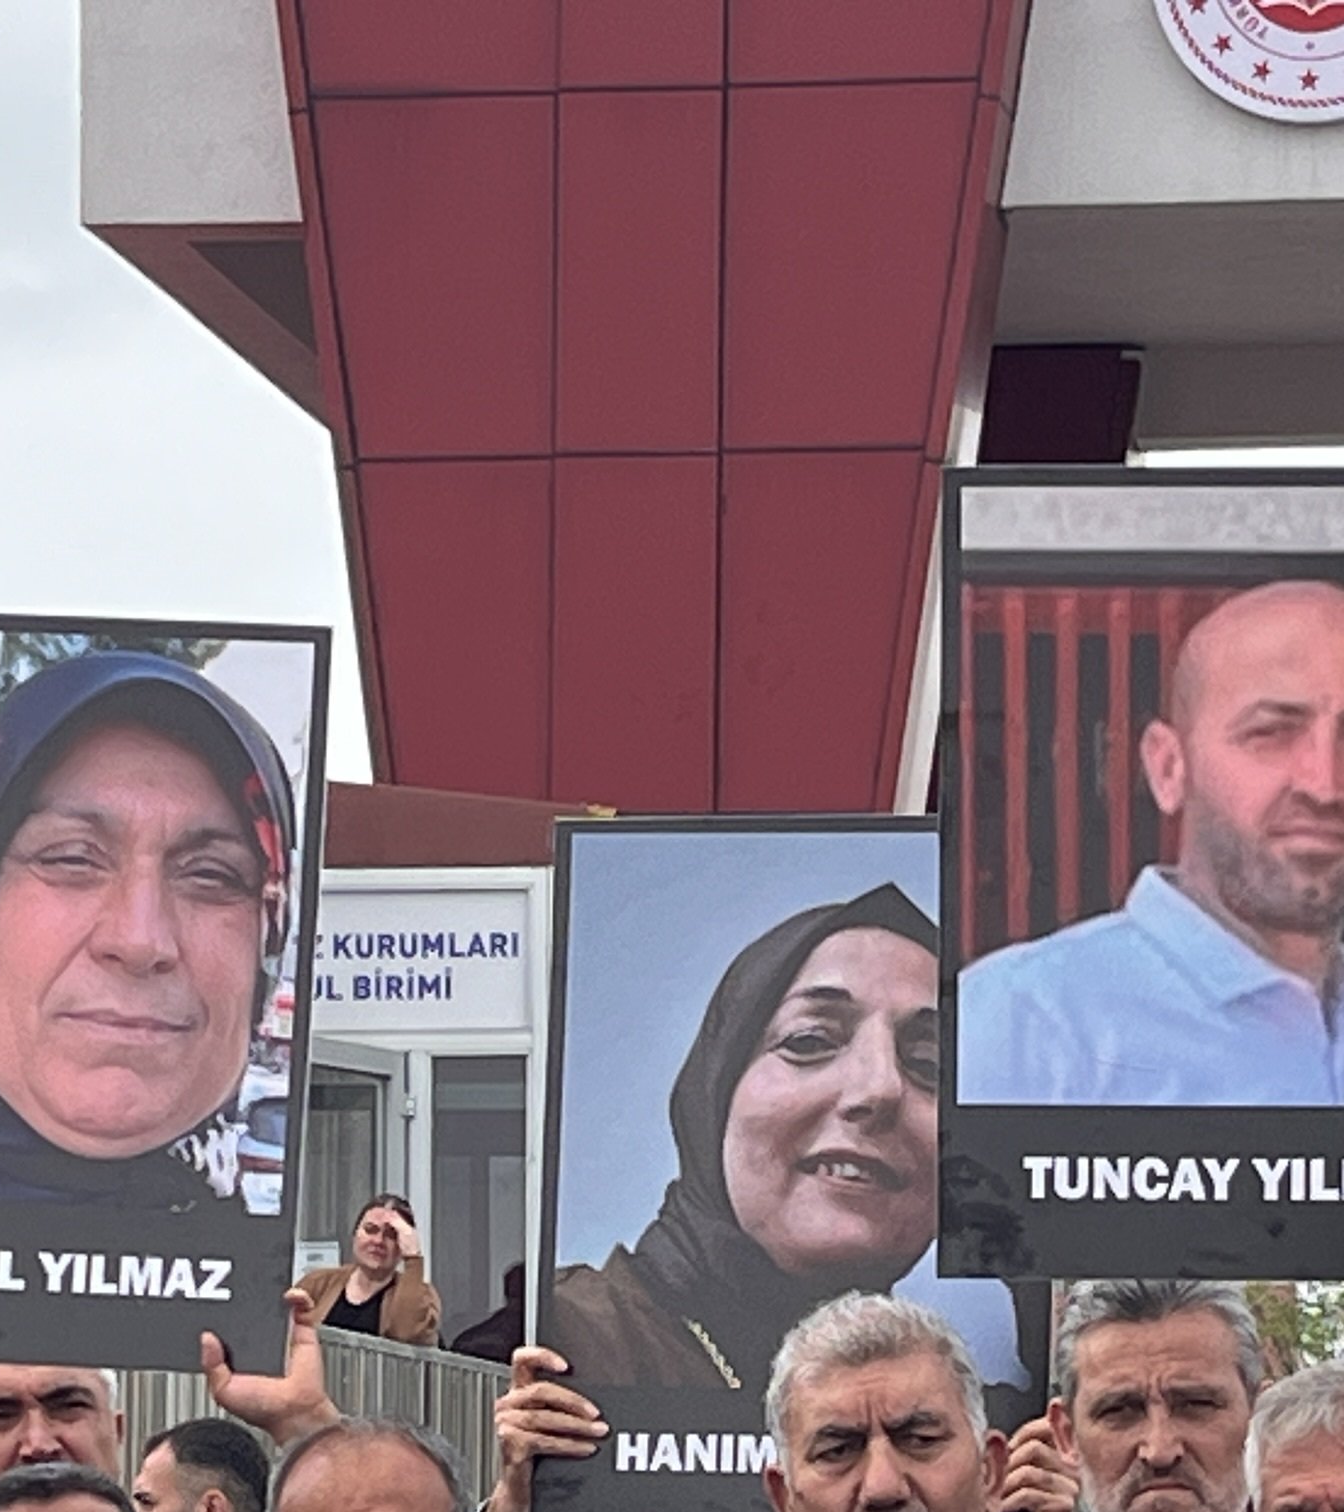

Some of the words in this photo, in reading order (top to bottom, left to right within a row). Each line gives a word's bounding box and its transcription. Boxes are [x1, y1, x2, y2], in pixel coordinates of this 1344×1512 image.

[333, 932, 520, 959] KURUMLARI
[352, 967, 453, 1001] BİRİMİ
[1022, 1155, 1239, 1201] TUNCAY
[38, 1251, 233, 1301] YILMAZ
[615, 1432, 779, 1474] HANIM
